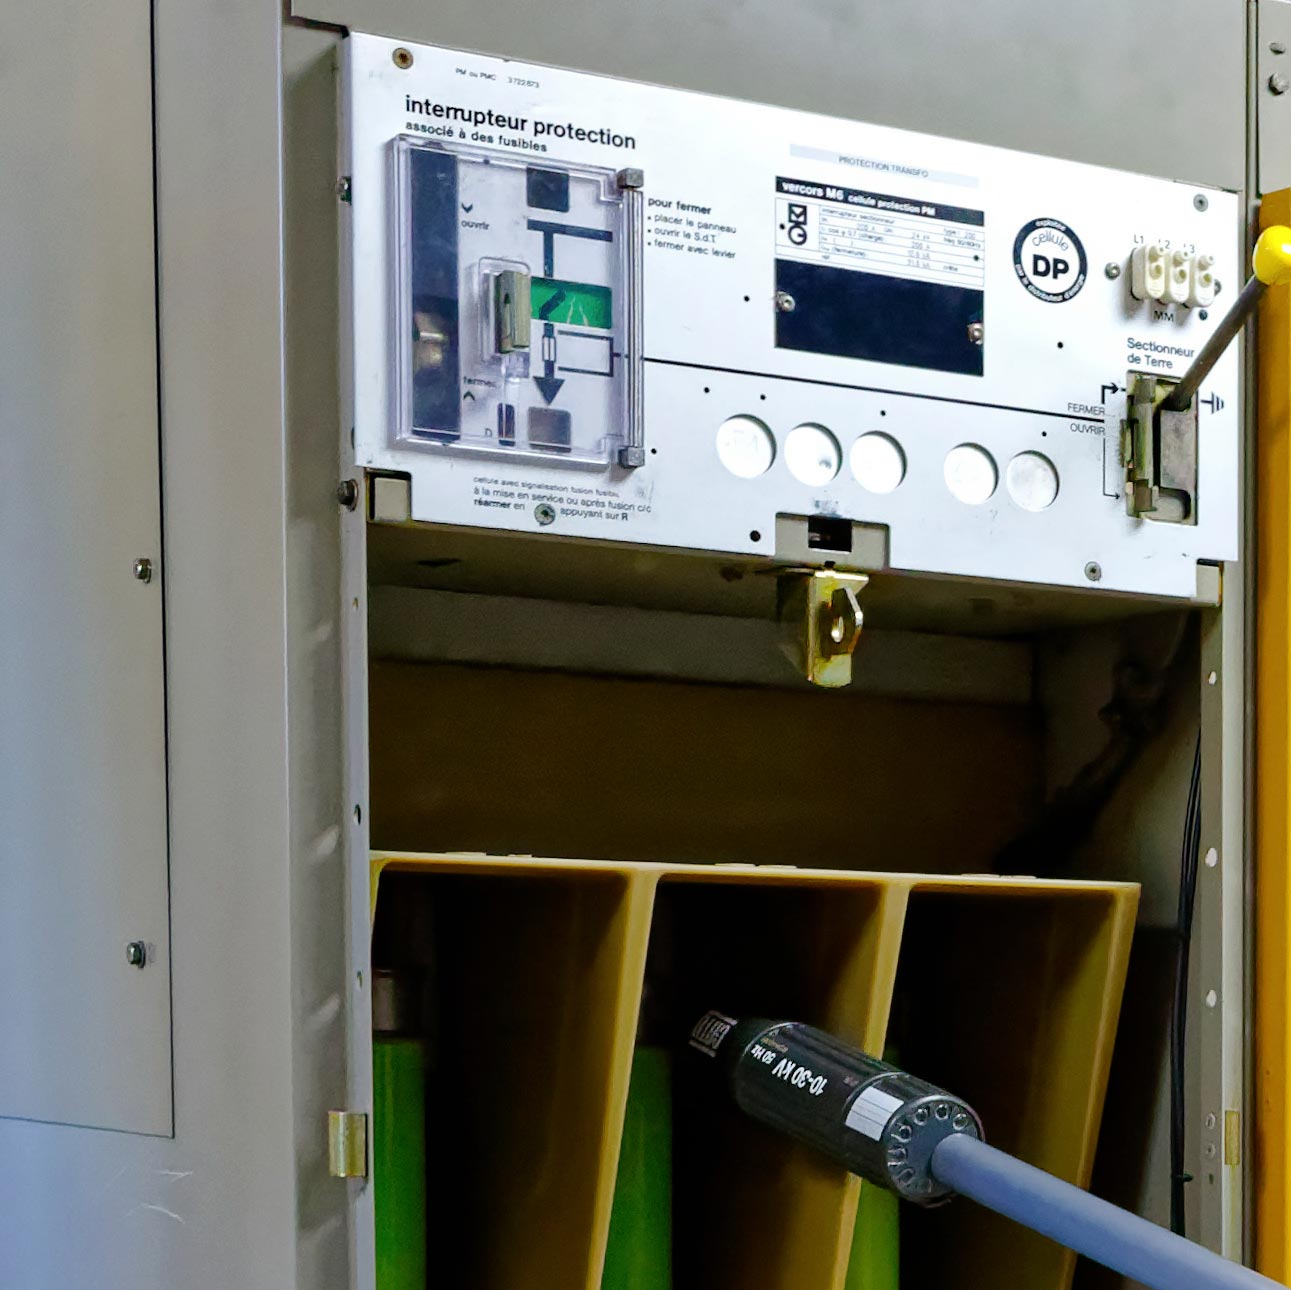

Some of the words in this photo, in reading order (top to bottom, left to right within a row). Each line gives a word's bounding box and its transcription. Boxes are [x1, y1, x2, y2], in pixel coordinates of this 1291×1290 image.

[405, 94, 527, 131] interrupteur
[533, 119, 636, 149] protection
[405, 121, 454, 137] associé
[458, 127, 466, 139] à
[471, 130, 494, 144] des
[499, 136, 547, 152] fusibles
[838, 156, 890, 172] PROTECTION
[890, 164, 929, 178] TRANSFO
[648, 198, 673, 210] pour
[676, 202, 711, 215] fermer
[782, 180, 824, 198] vercors
[826, 186, 844, 200] M6
[848, 192, 877, 206] cellule
[877, 198, 920, 214] protection
[654, 214, 682, 228] placer
[684, 218, 694, 228] le
[697, 221, 737, 234] panneau
[654, 227, 679, 238] ouvrir
[682, 230, 692, 239] le
[1032, 230, 1069, 252] cellule
[1134, 234, 1144, 244] L1
[654, 239, 685, 252] fermer
[687, 245, 709, 256] avec
[710, 248, 736, 260] levier
[1033, 254, 1070, 280] DP
[1154, 310, 1174, 322] MM
[1126, 337, 1195, 358] Sectionneur
[1126, 354, 1141, 365] de
[1144, 355, 1173, 370] Terre
[1067, 402, 1106, 416] FERMER
[1070, 422, 1106, 436] OUVRIR
[492, 489, 515, 499] mise
[532, 494, 565, 503] service
[580, 497, 606, 508] après
[608, 500, 635, 510] fusion
[513, 502, 525, 510] en
[560, 507, 603, 520] appuyant
[604, 512, 620, 520] sur
[750, 1044, 767, 1059] Hz
[762, 1052, 777, 1065] 50
[772, 1058, 797, 1081] kV
[791, 1066, 828, 1096] 10-30
